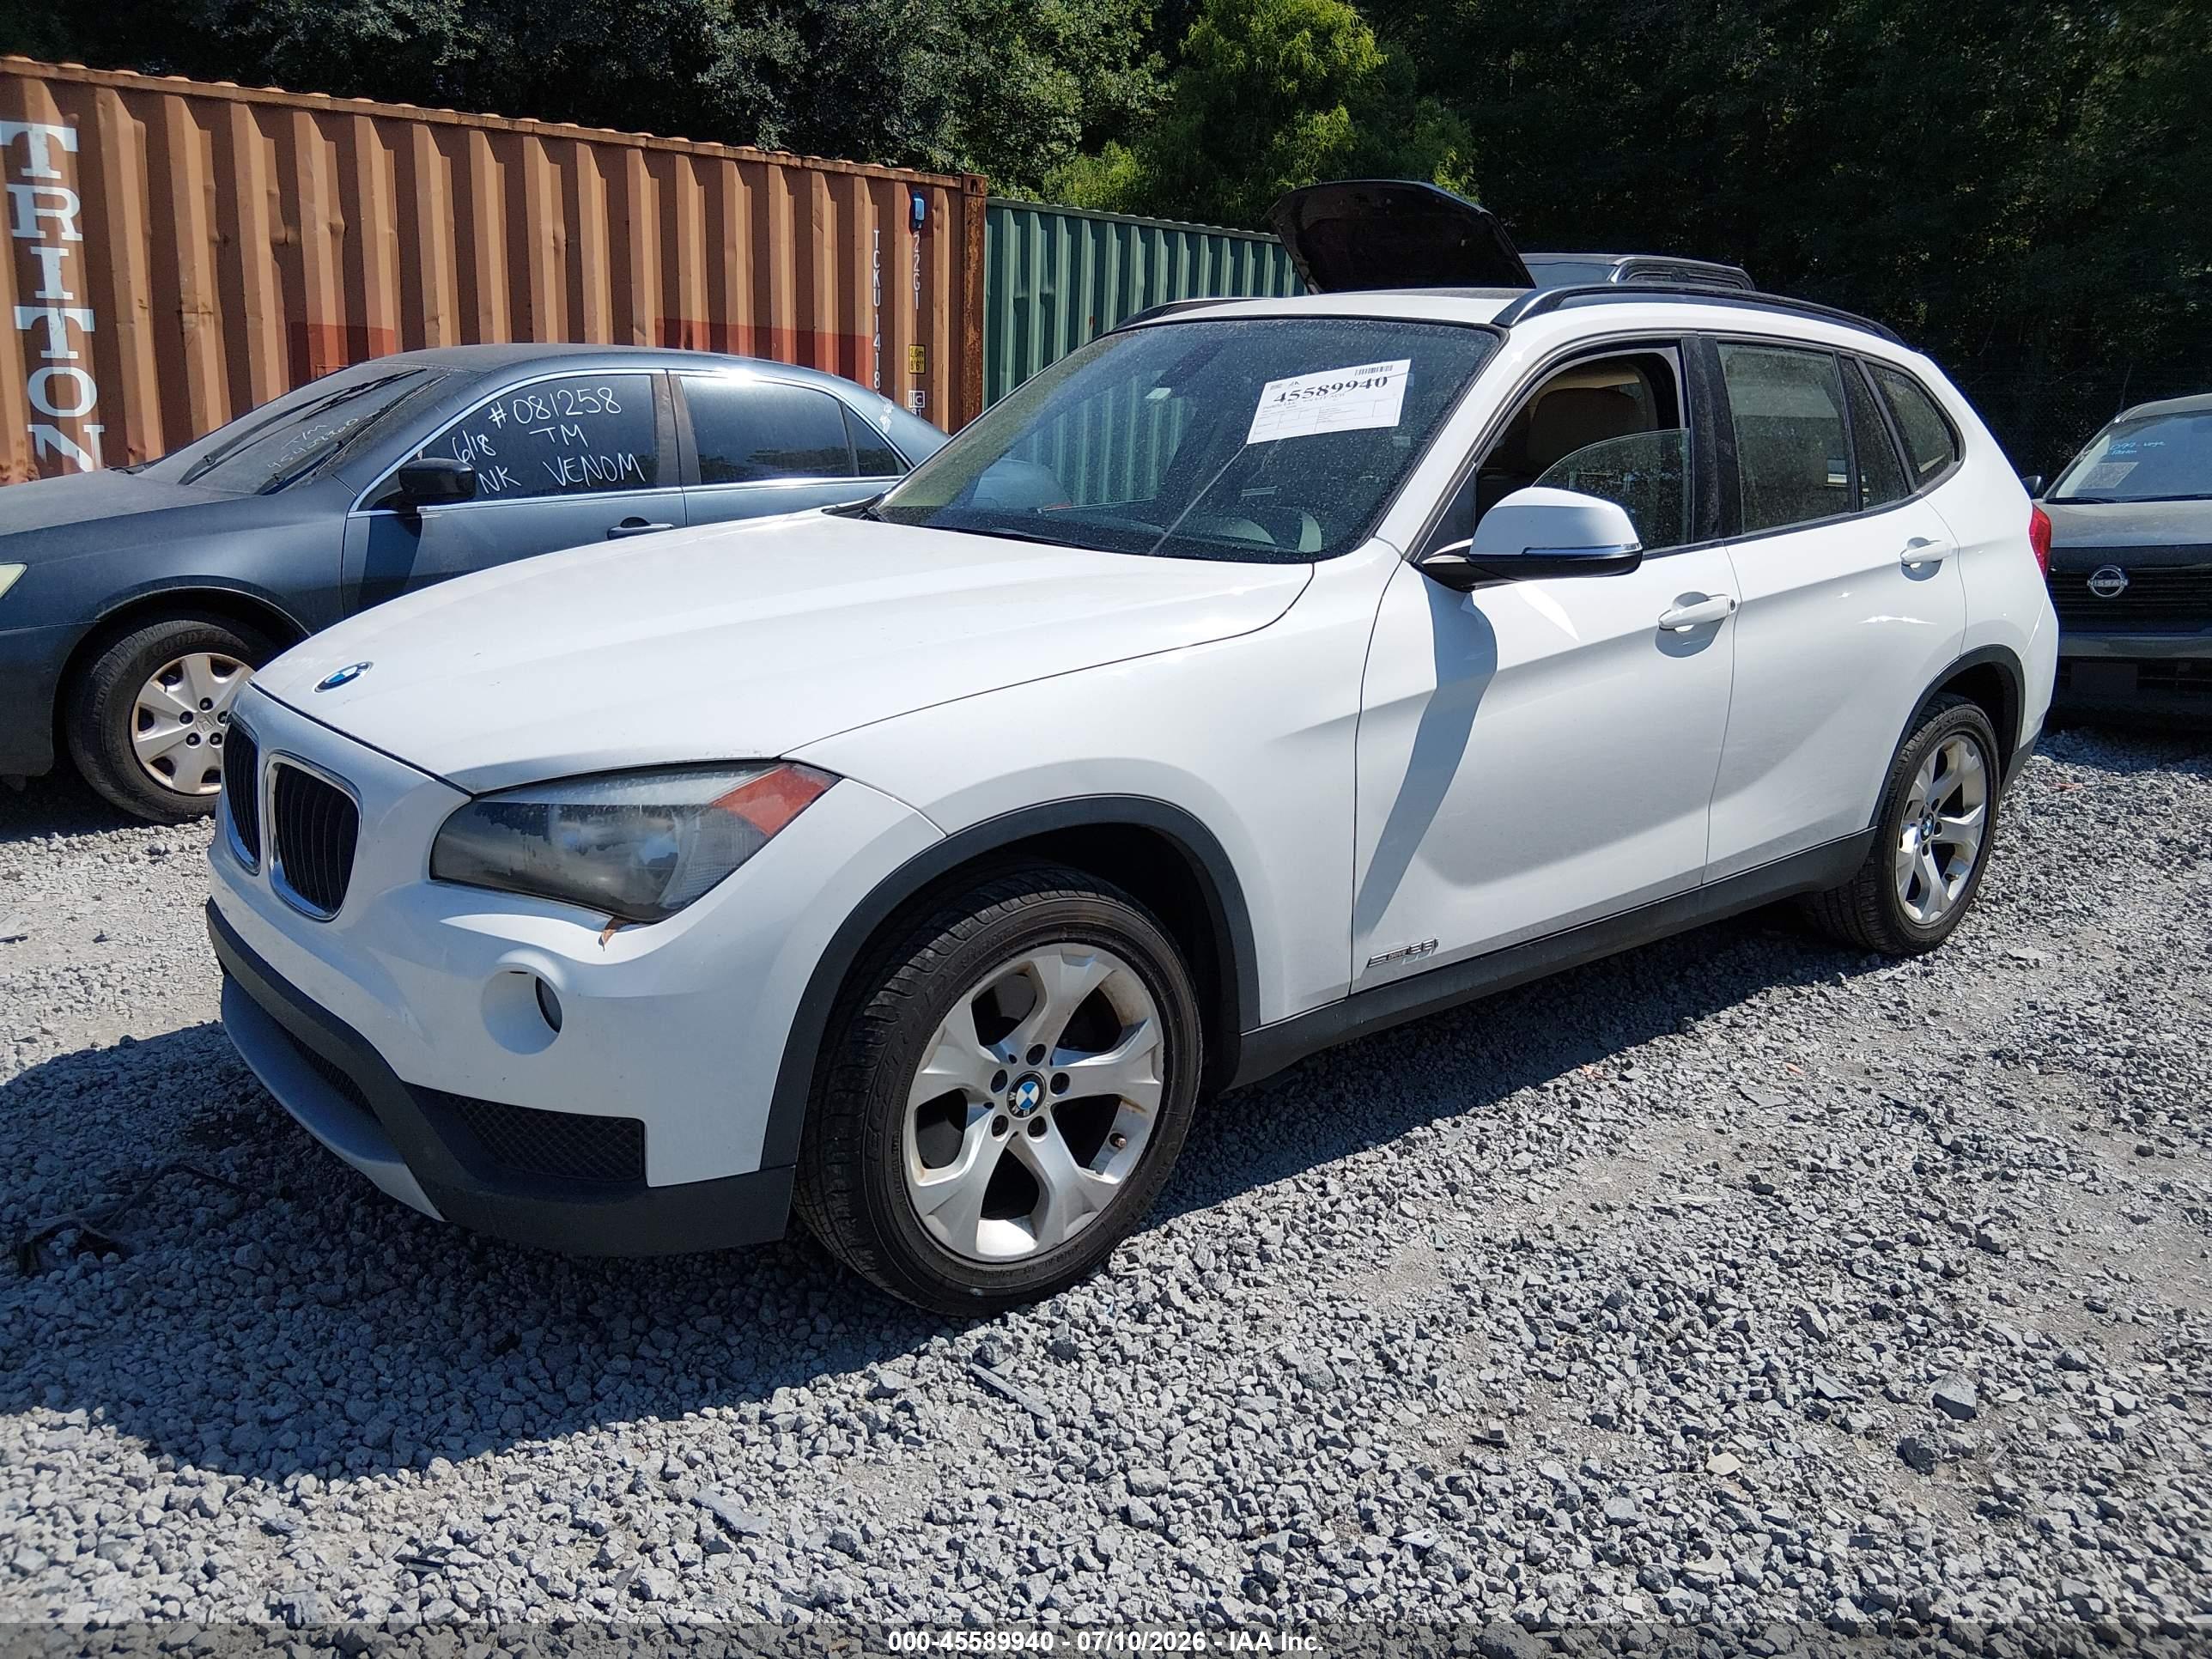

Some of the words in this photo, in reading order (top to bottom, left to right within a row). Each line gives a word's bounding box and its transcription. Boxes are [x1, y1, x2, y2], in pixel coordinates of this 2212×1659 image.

[872, 229, 881, 307] TCKU
[913, 230, 921, 310] 22G1
[0, 120, 104, 472] TRITON
[488, 387, 623, 428] #081258
[1273, 376, 1388, 404] 45589940
[452, 430, 496, 463] 6/18
[529, 424, 589, 448] TM
[477, 465, 522, 495] NK
[542, 453, 647, 487] VENOM
[2087, 579, 2129, 588] NISSAN
